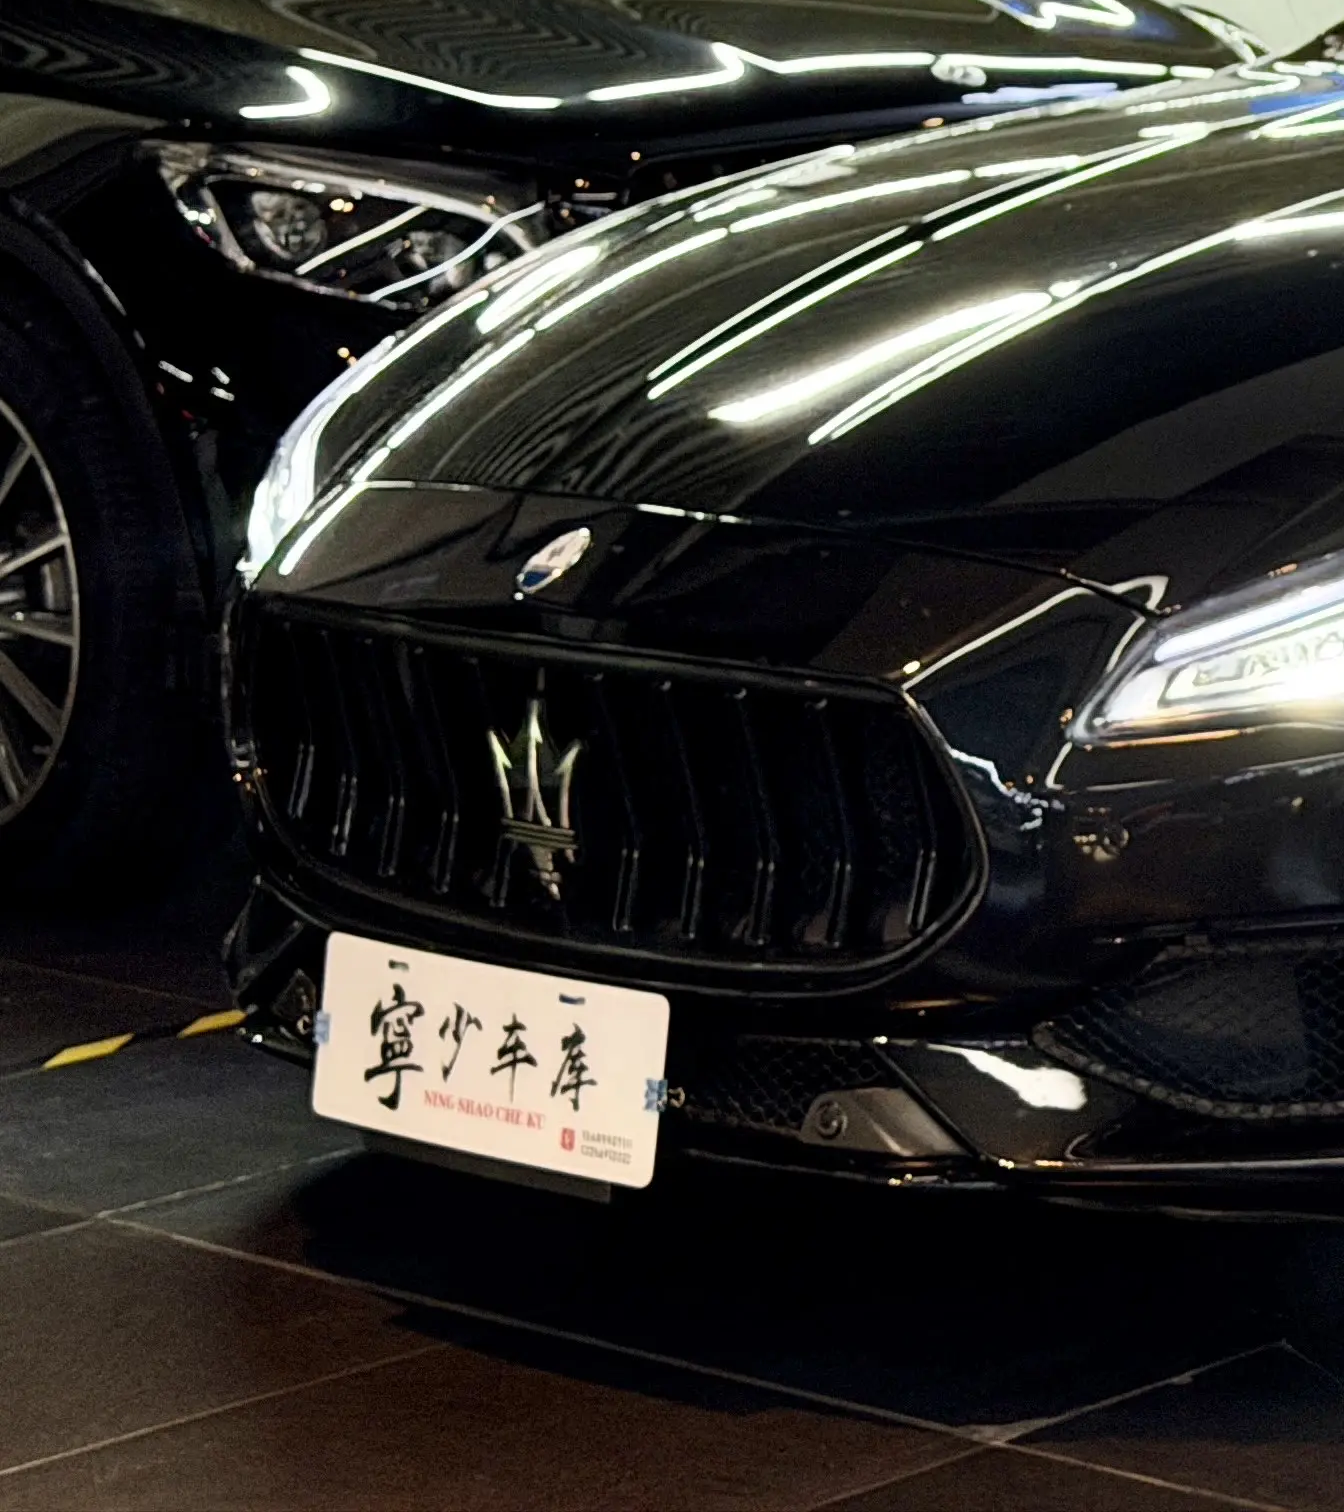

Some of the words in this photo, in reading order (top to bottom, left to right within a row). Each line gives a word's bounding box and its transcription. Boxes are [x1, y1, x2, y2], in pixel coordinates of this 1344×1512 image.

[423, 1089, 456, 1111] NING
[456, 1096, 494, 1120] SHAO
[495, 1102, 526, 1127] CHE
[526, 1110, 546, 1130] KU
